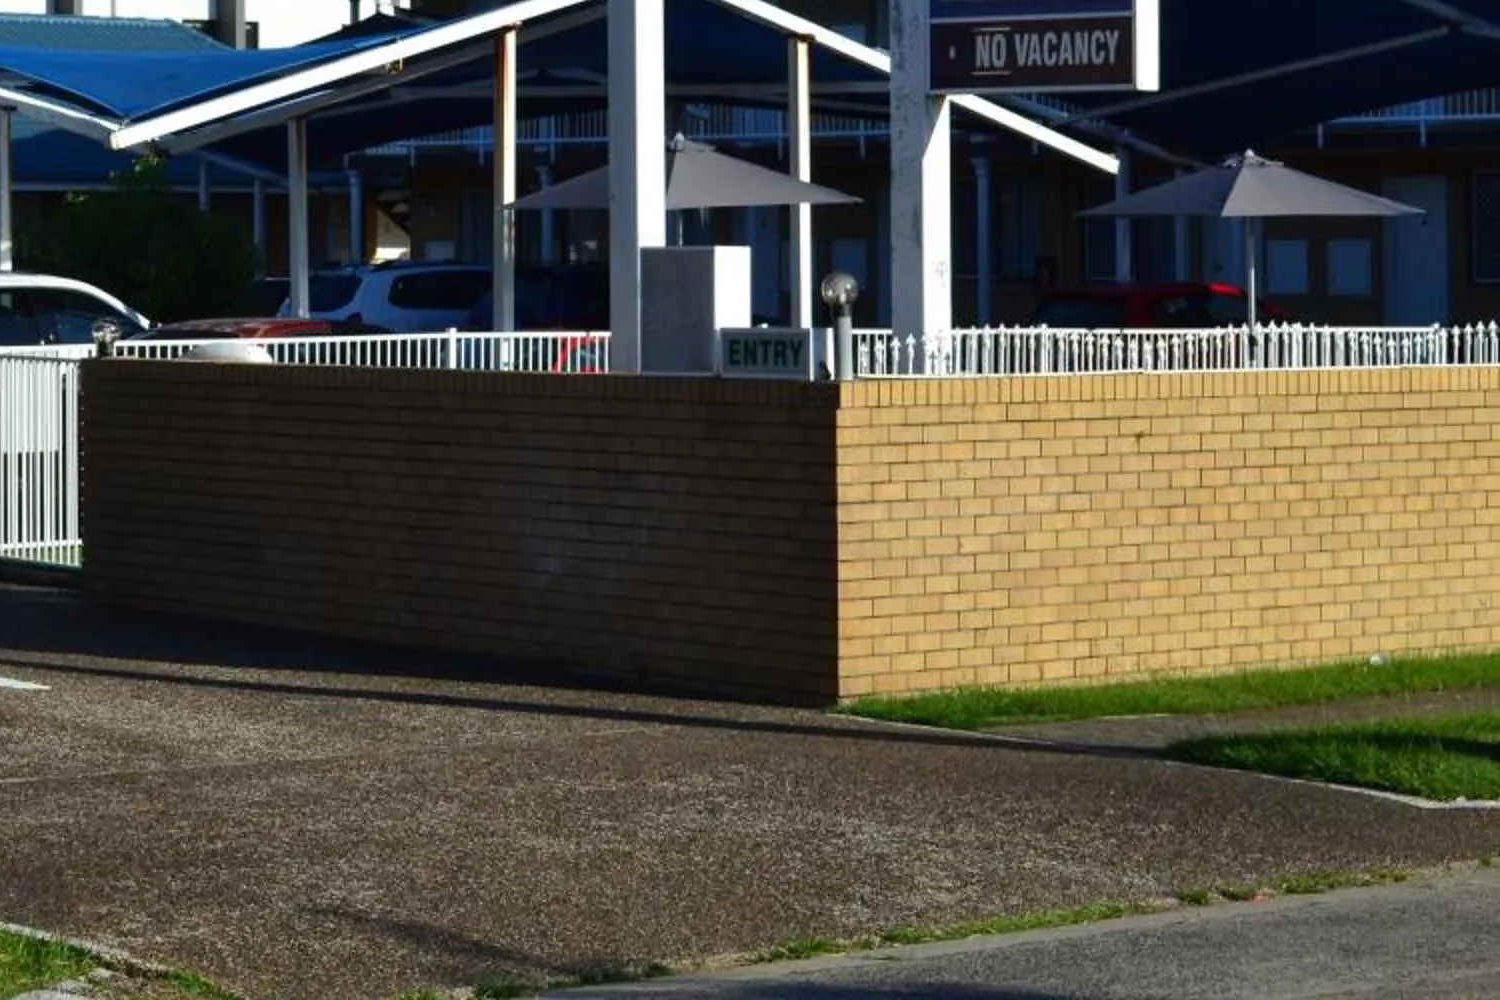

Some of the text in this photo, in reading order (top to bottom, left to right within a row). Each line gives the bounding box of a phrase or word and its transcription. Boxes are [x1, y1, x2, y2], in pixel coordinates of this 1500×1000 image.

[974, 29, 1120, 69] NO VACANCY
[728, 339, 803, 367] ENTRY
